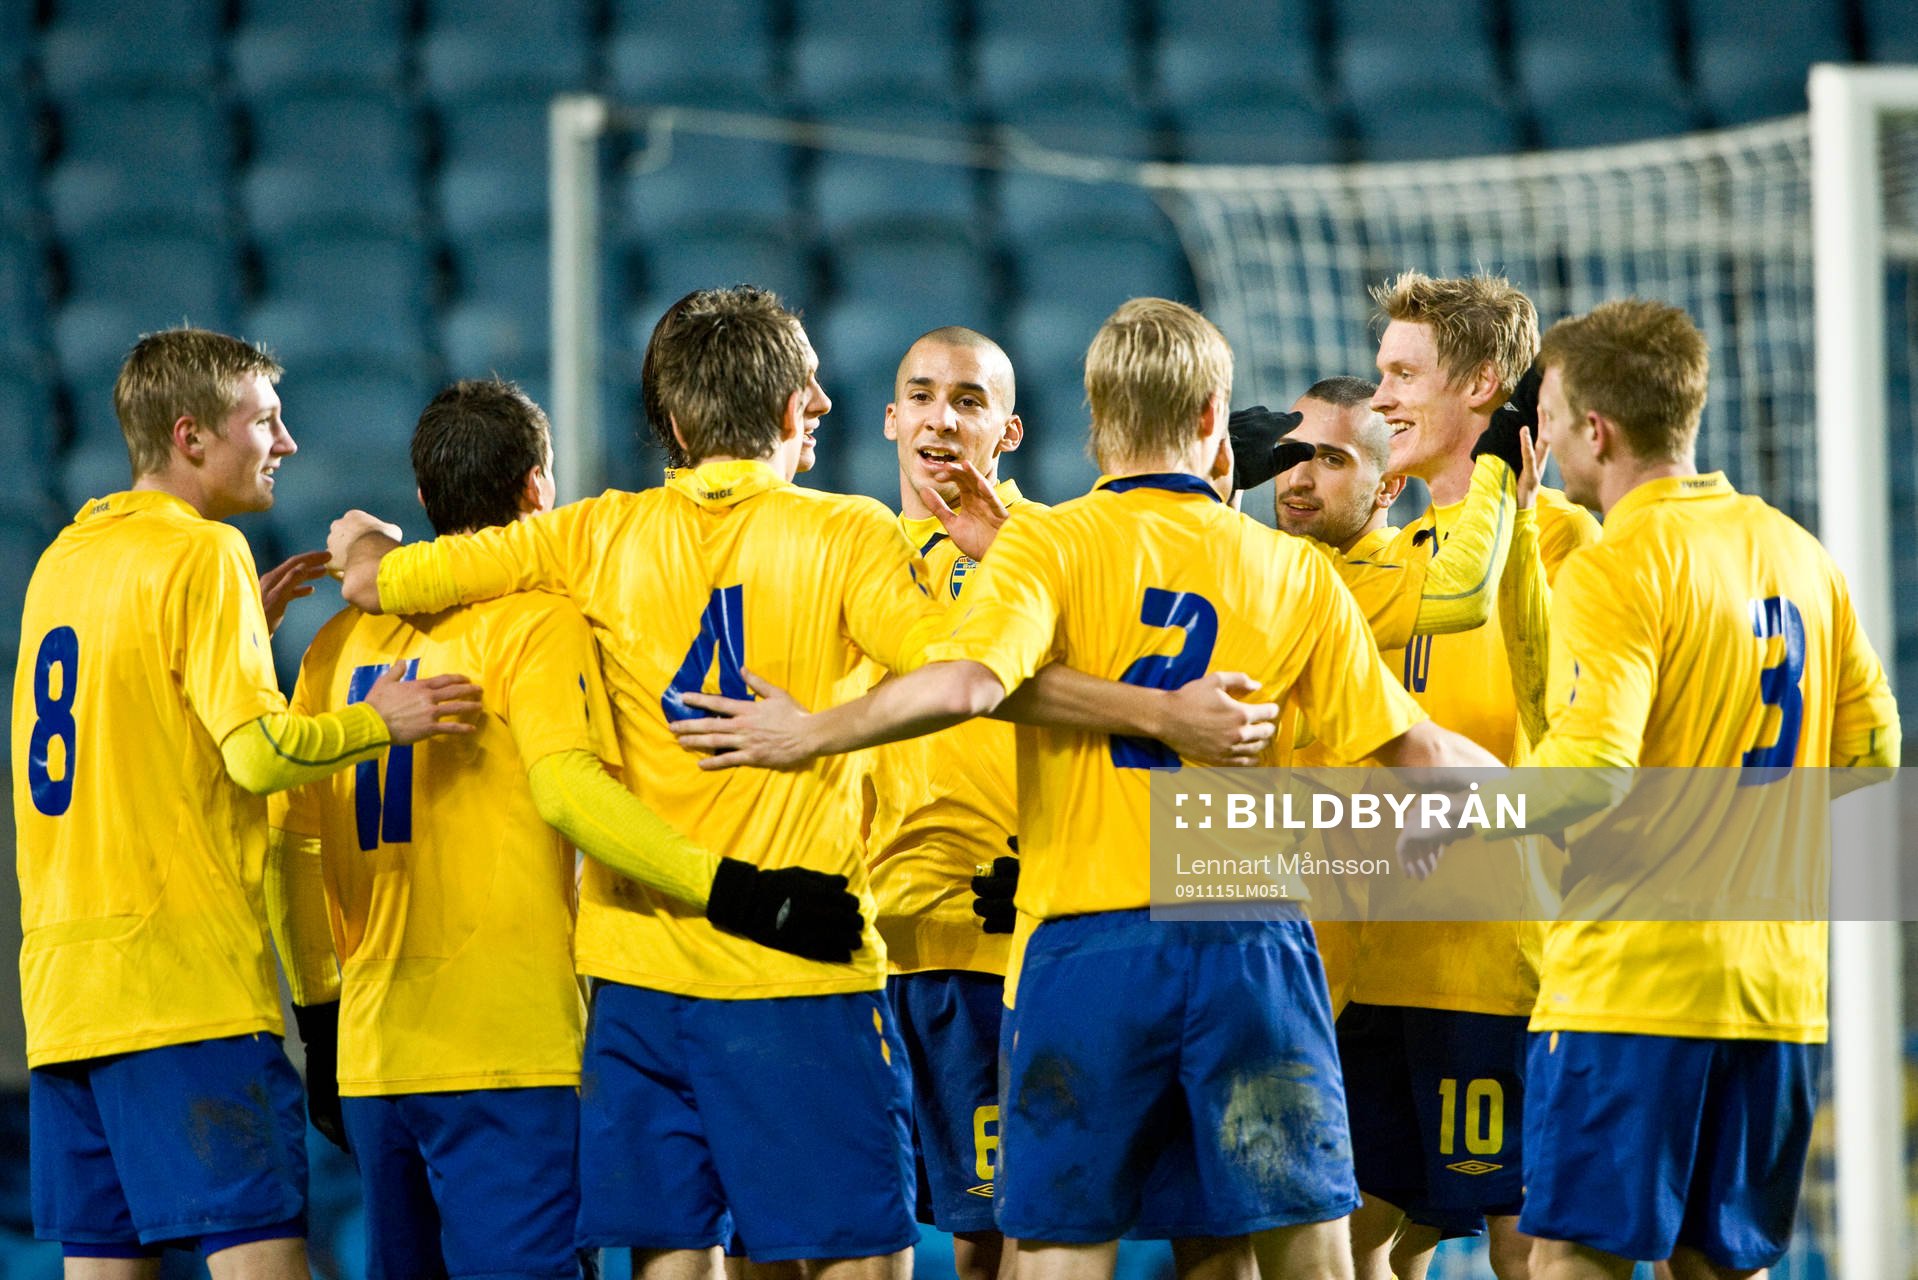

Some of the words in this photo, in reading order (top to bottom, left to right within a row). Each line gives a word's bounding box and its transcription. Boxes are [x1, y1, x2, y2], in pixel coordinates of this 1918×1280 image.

[28, 625, 79, 816] 8
[661, 584, 756, 755] 4
[1109, 587, 1218, 773] 2
[1738, 596, 1806, 787] 3
[1438, 1079, 1504, 1155] 10
